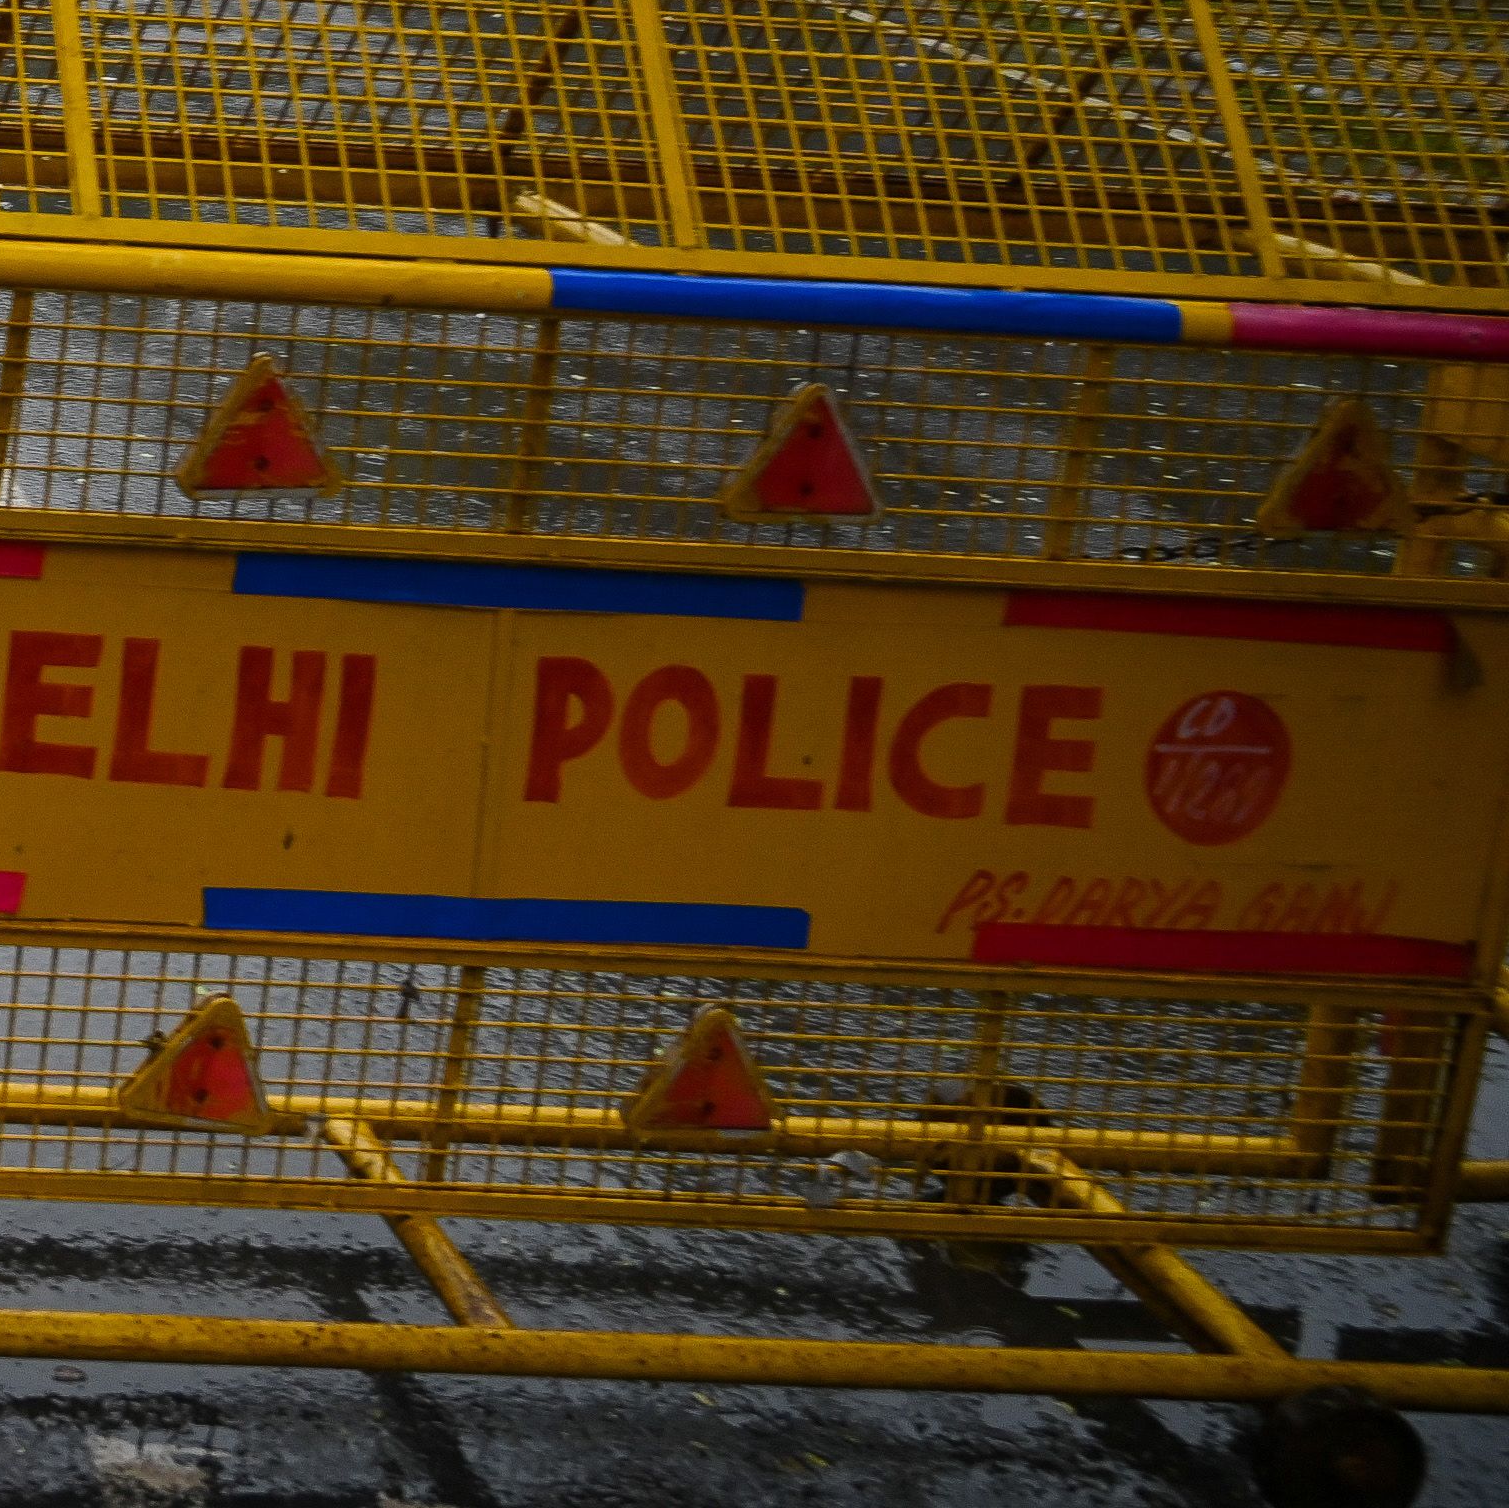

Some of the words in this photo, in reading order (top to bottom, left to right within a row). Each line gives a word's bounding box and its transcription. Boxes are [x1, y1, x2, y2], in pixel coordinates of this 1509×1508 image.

[522, 655, 1103, 828] POLICE
[1176, 696, 1237, 740] CD
[1036, 875, 1224, 926] DARYA
